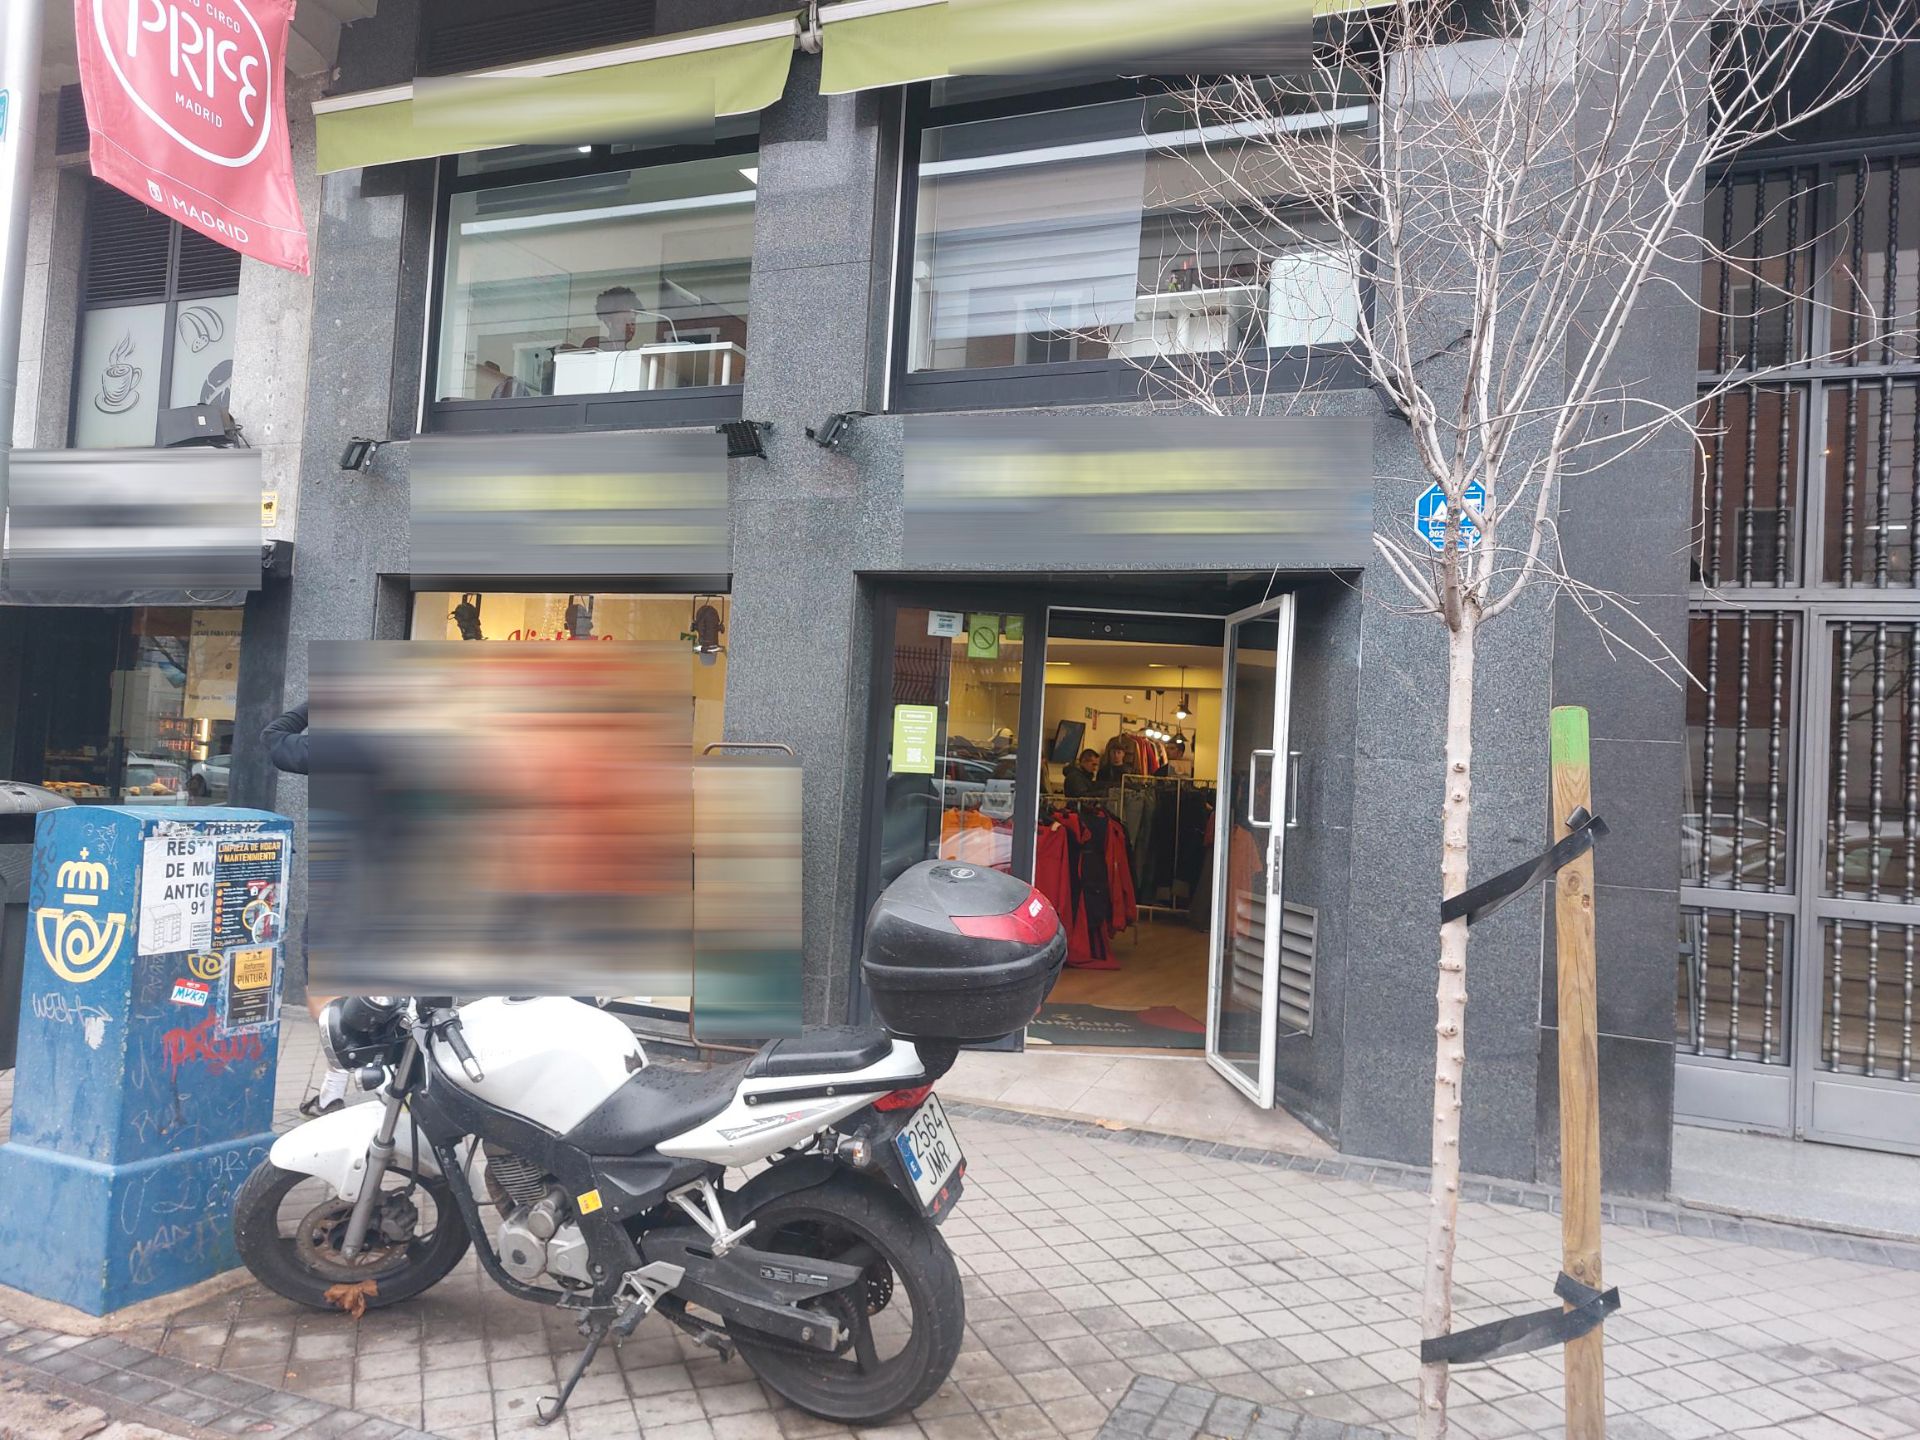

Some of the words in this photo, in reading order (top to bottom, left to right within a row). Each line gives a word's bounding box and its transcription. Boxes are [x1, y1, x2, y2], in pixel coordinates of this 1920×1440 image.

[206, 3, 242, 34] CIRCO
[125, 0, 259, 128] PRICE
[175, 91, 223, 129] MADRID
[171, 194, 249, 243] MADRID
[250, 843, 259, 851] DE
[165, 863, 185, 878] DE
[218, 855, 224, 863] Y
[191, 901, 206, 915] 91
[237, 972, 268, 985] PINTURA
[908, 1103, 944, 1159] 2564
[909, 1160, 917, 1172] E
[925, 1141, 951, 1185] JMR
